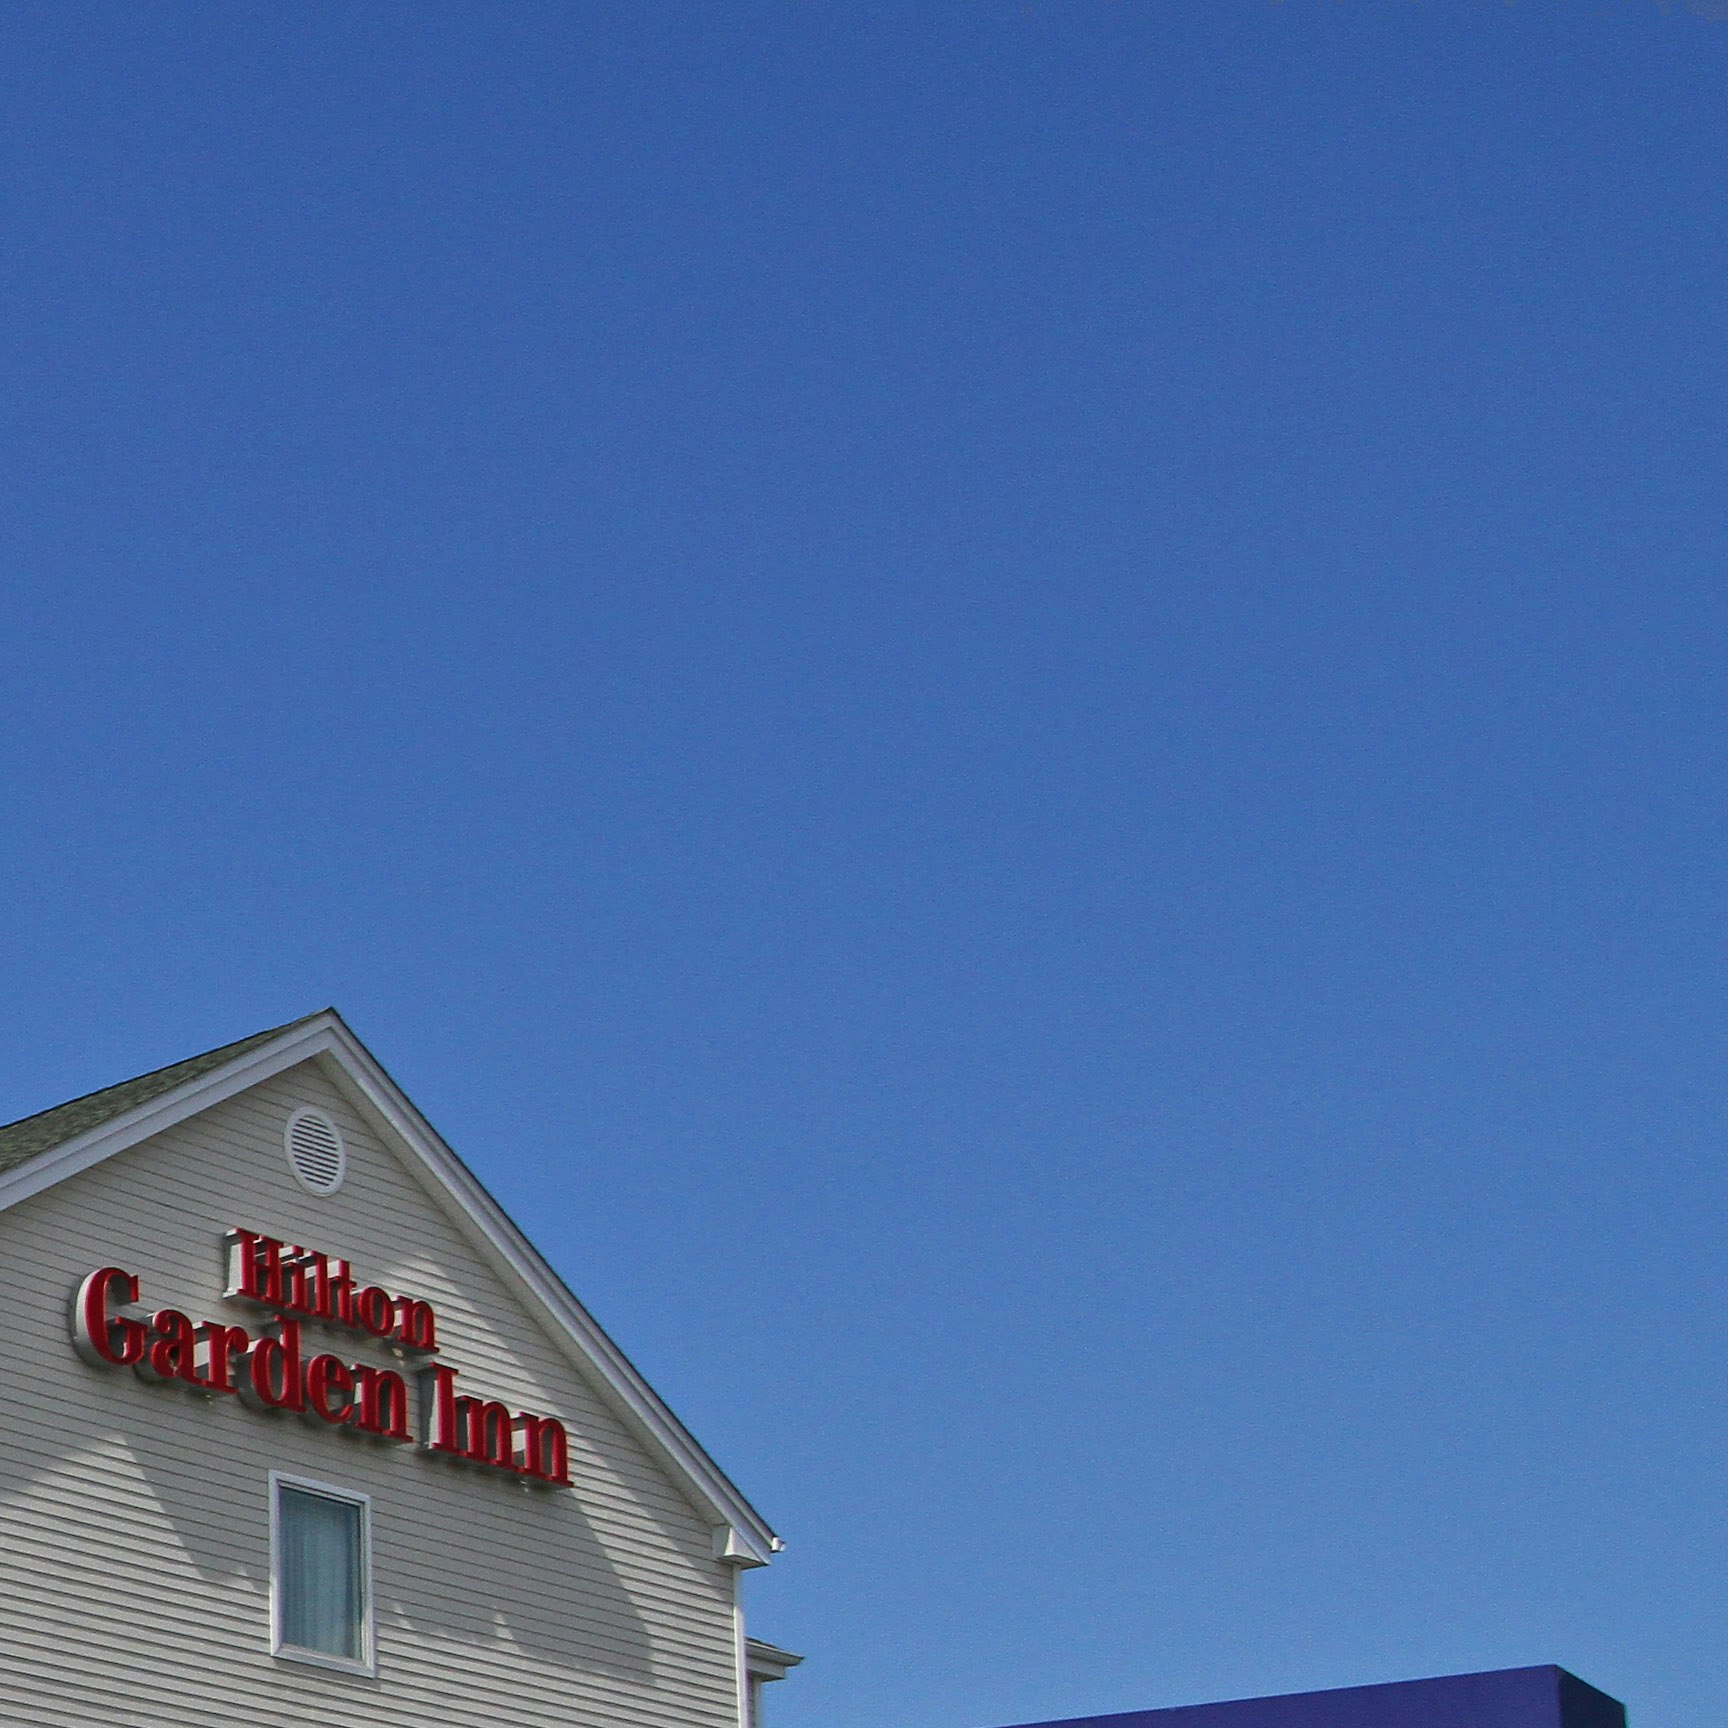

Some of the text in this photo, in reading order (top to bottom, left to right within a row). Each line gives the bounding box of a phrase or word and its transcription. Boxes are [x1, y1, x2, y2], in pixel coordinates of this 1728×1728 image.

[76, 1264, 576, 1489] Garden Inn
[227, 1226, 440, 1355] Hilton
